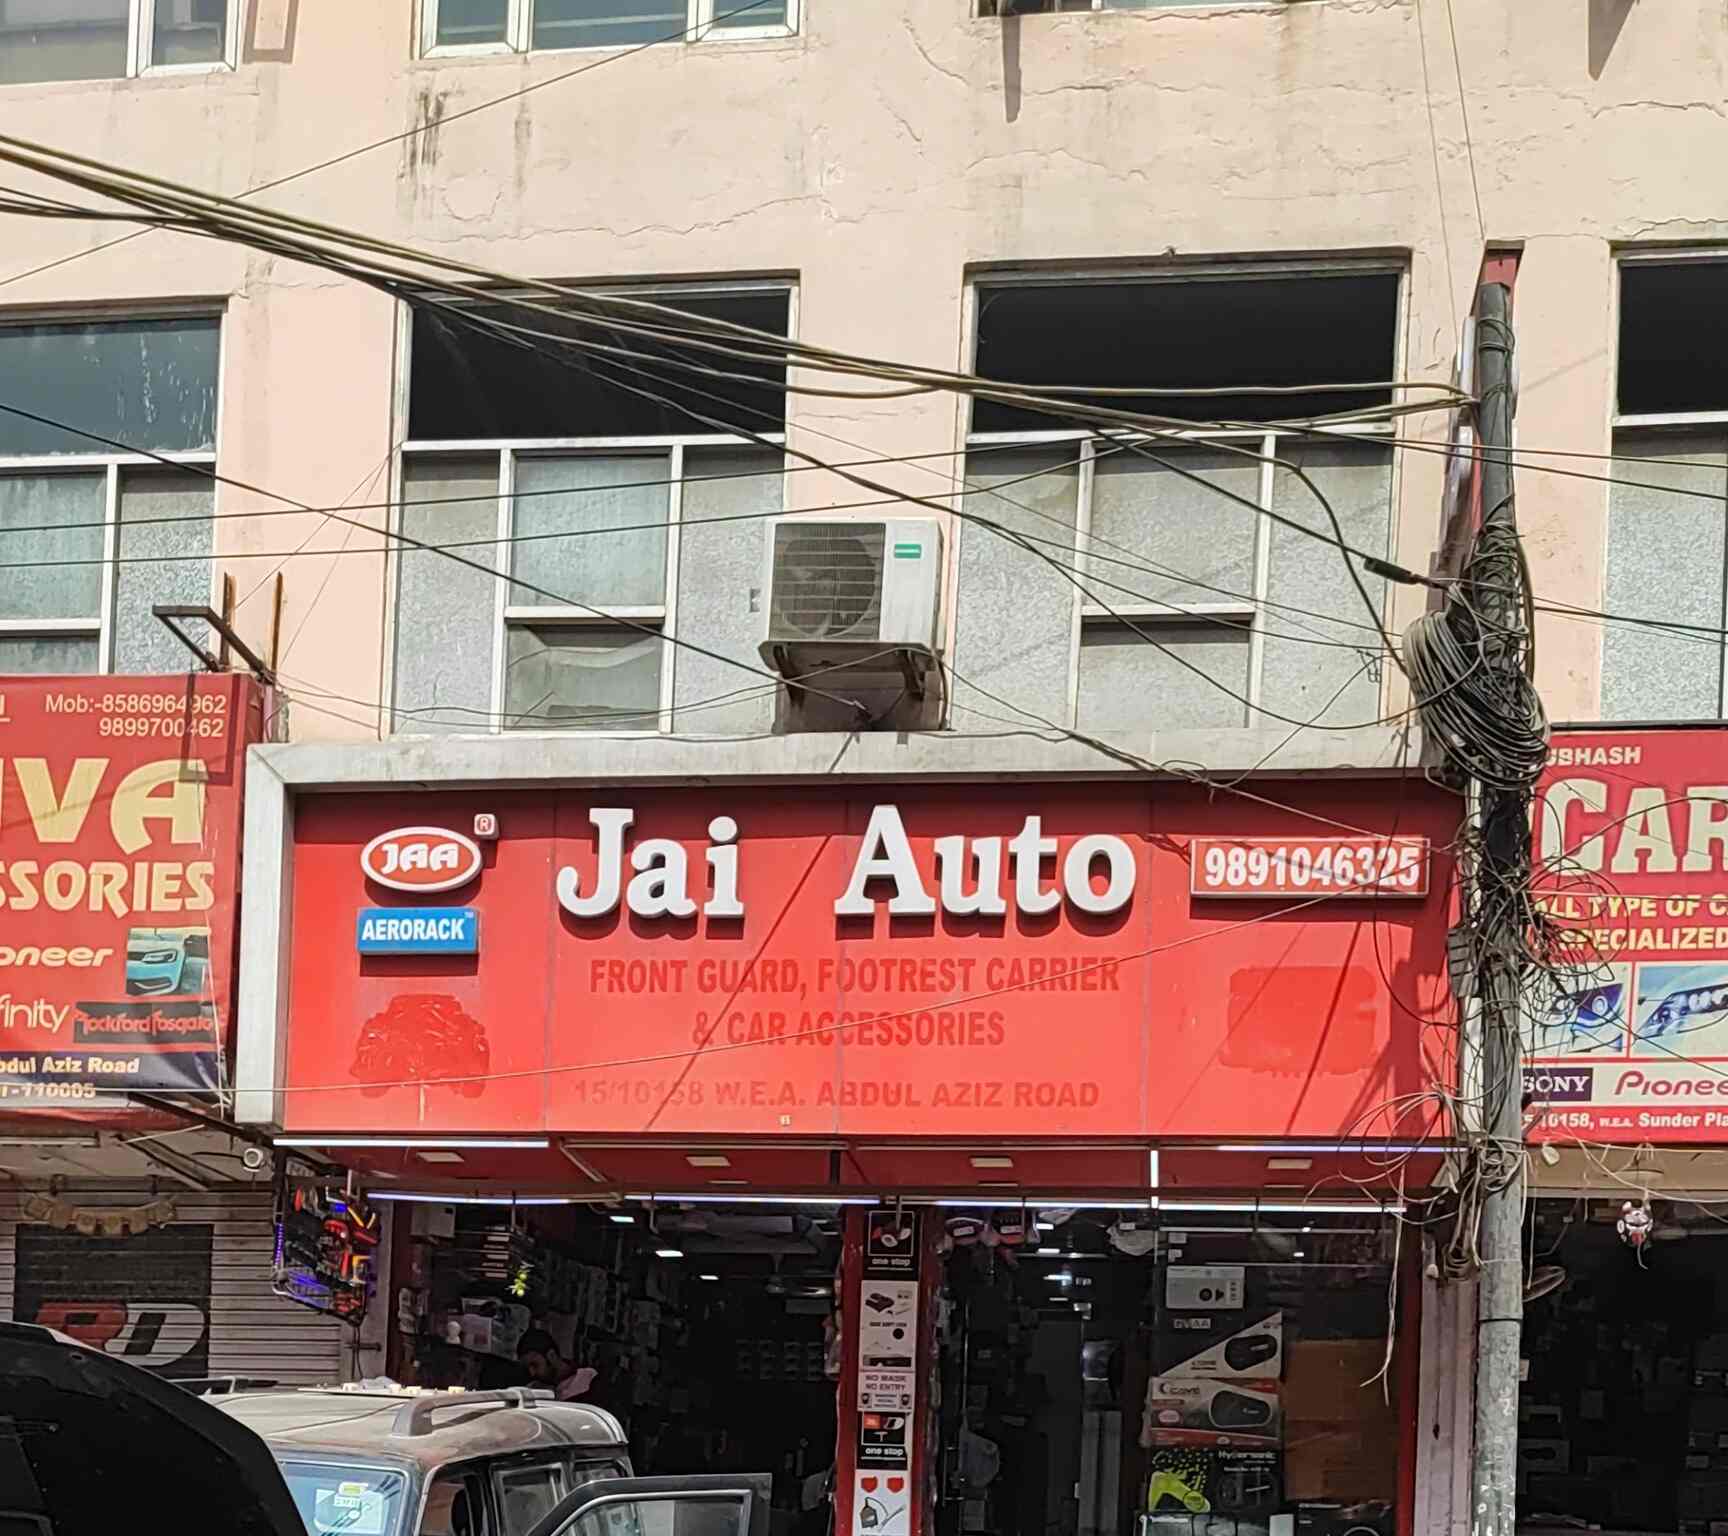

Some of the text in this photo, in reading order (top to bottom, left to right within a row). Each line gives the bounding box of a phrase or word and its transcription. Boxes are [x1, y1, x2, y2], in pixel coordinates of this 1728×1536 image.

[1546, 746, 1641, 766] UBHASH
[0, 757, 208, 855] VA
[380, 843, 459, 874] JAA
[556, 804, 1137, 919] Jai Auto
[1205, 845, 1420, 887] 9891046325
[0, 860, 215, 919] SORIES
[1588, 896, 1657, 918] TYPE
[1665, 894, 1701, 917] OF
[362, 918, 465, 941] AERORACK
[590, 956, 1120, 999] FRONT GUARD, FOOTREST CARRIER
[692, 1010, 1006, 1047] & CAR ACCESSORIES
[42, 1057, 82, 1073] Aziz
[88, 1057, 141, 1074] Road
[715, 1081, 805, 1106] W.E.A.
[816, 1081, 921, 1108] ABDUL
[931, 1081, 1003, 1107] AZIZ
[1014, 1080, 1100, 1107] ROAD
[1522, 1076, 1590, 1093] SONY
[1638, 1112, 1701, 1128] Sunder
